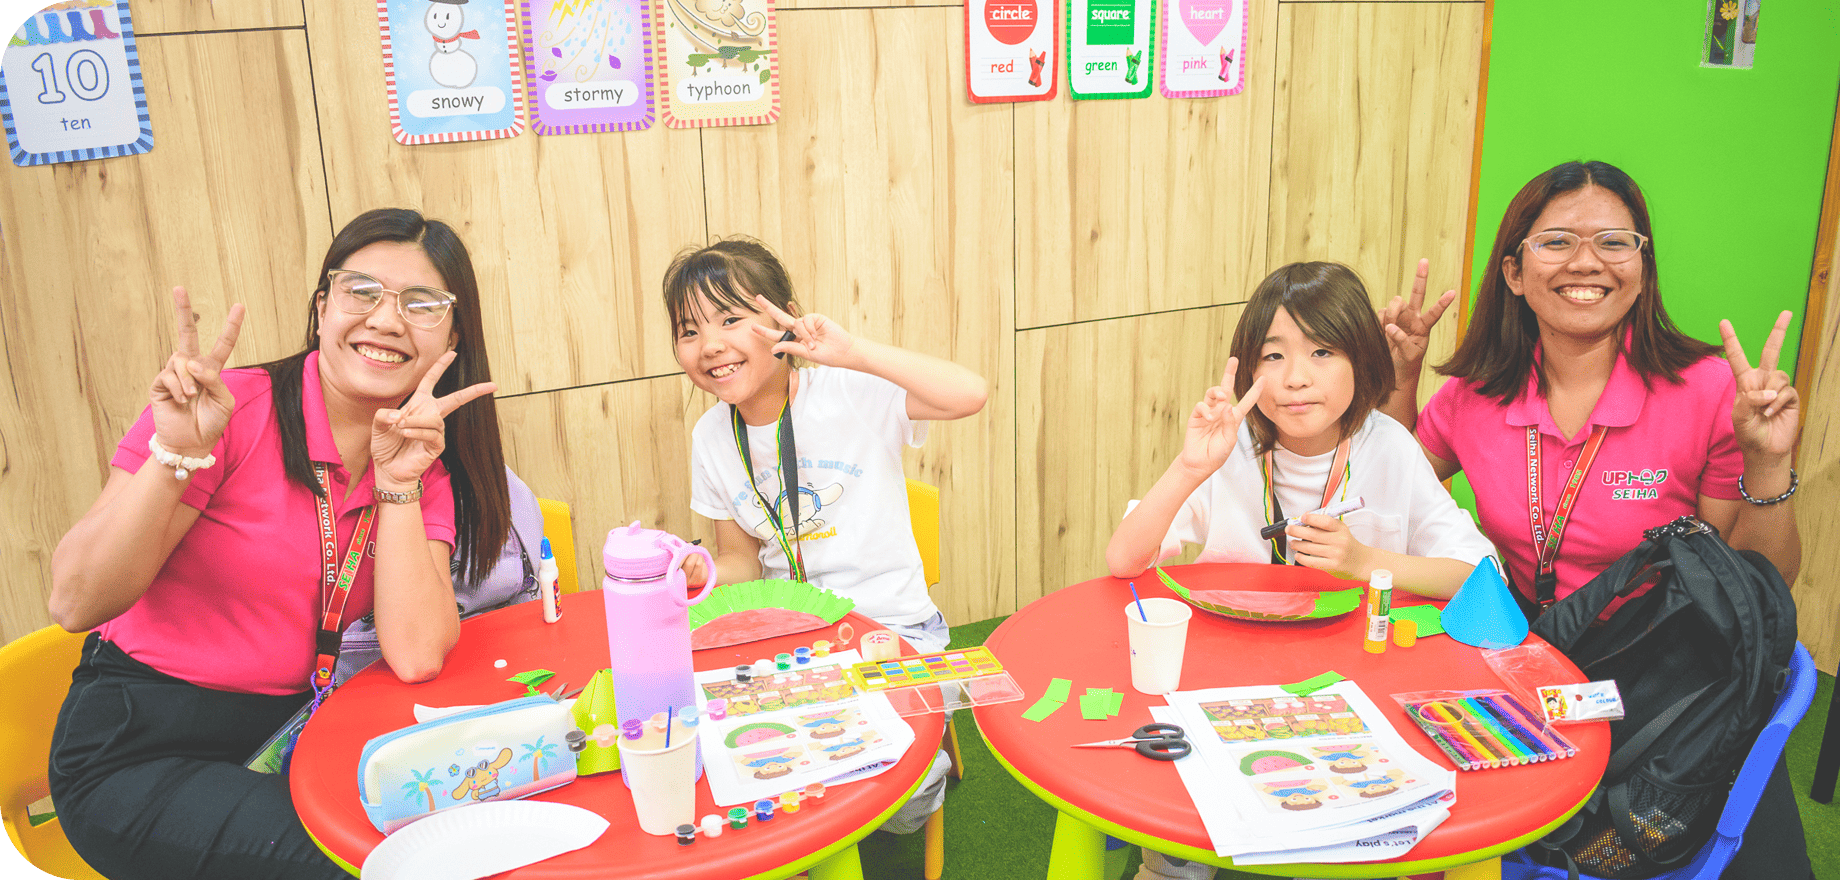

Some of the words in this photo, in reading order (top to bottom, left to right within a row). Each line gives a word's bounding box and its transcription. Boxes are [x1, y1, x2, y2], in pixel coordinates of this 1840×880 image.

[992, 5, 1031, 21] circle
[1091, 7, 1130, 24] square
[1190, 5, 1224, 20] heart
[991, 60, 1014, 73] red
[1085, 60, 1118, 75] green
[1183, 57, 1207, 73] pink
[31, 49, 110, 104] 10
[564, 86, 624, 103] stormy
[687, 82, 751, 100] typhoon
[431, 94, 485, 112] snowy
[60, 117, 91, 131] ten
[1529, 427, 1537, 456] Seiha
[818, 459, 863, 478] music
[1530, 458, 1539, 504] Network
[1612, 488, 1658, 500] SEIHA
[1531, 505, 1539, 523] Co.
[1533, 524, 1545, 544] Ltd.
[324, 541, 335, 561] Co.
[326, 563, 336, 586] Ltd.
[338, 551, 360, 591] SEIHA
[1355, 839, 1381, 848] play
